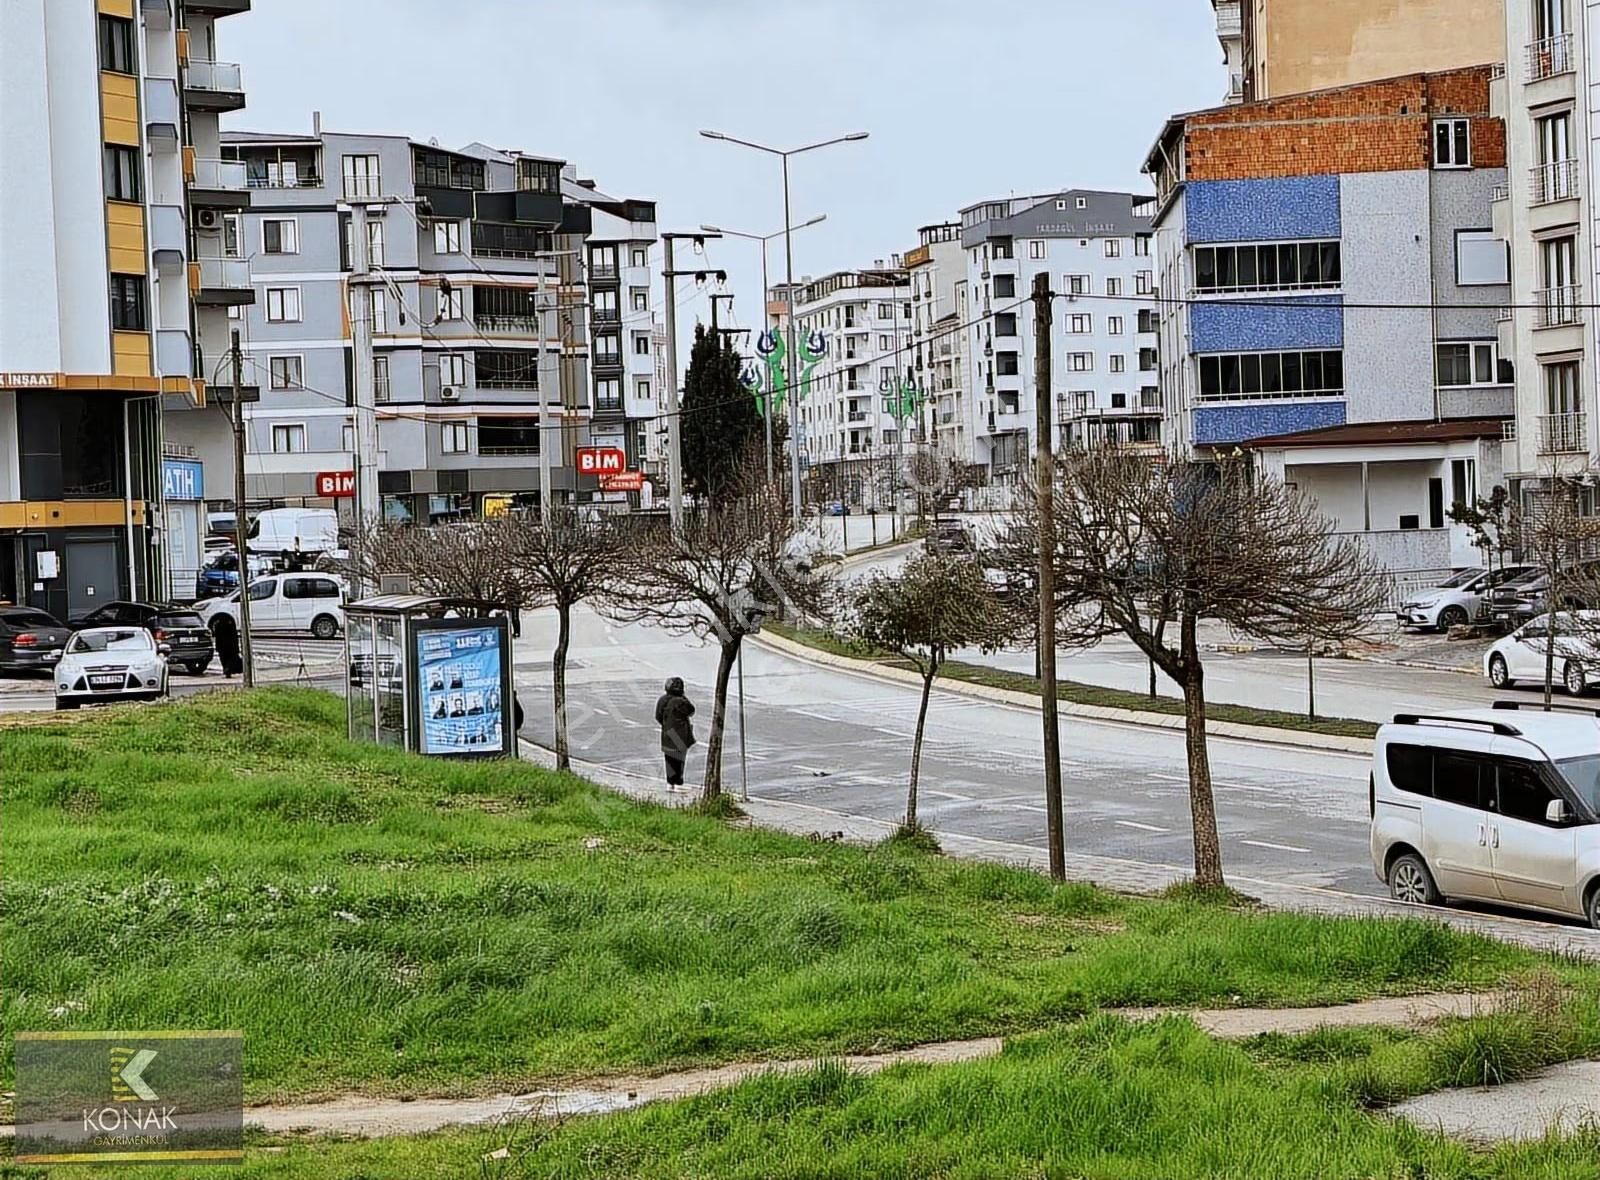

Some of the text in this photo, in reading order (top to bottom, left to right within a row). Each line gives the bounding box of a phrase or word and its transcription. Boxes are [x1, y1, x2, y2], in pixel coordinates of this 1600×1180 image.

[8, 371, 54, 387] İNŞAAT
[581, 450, 619, 470] BİM
[164, 463, 194, 494] ATİH
[322, 472, 354, 492] BİM
